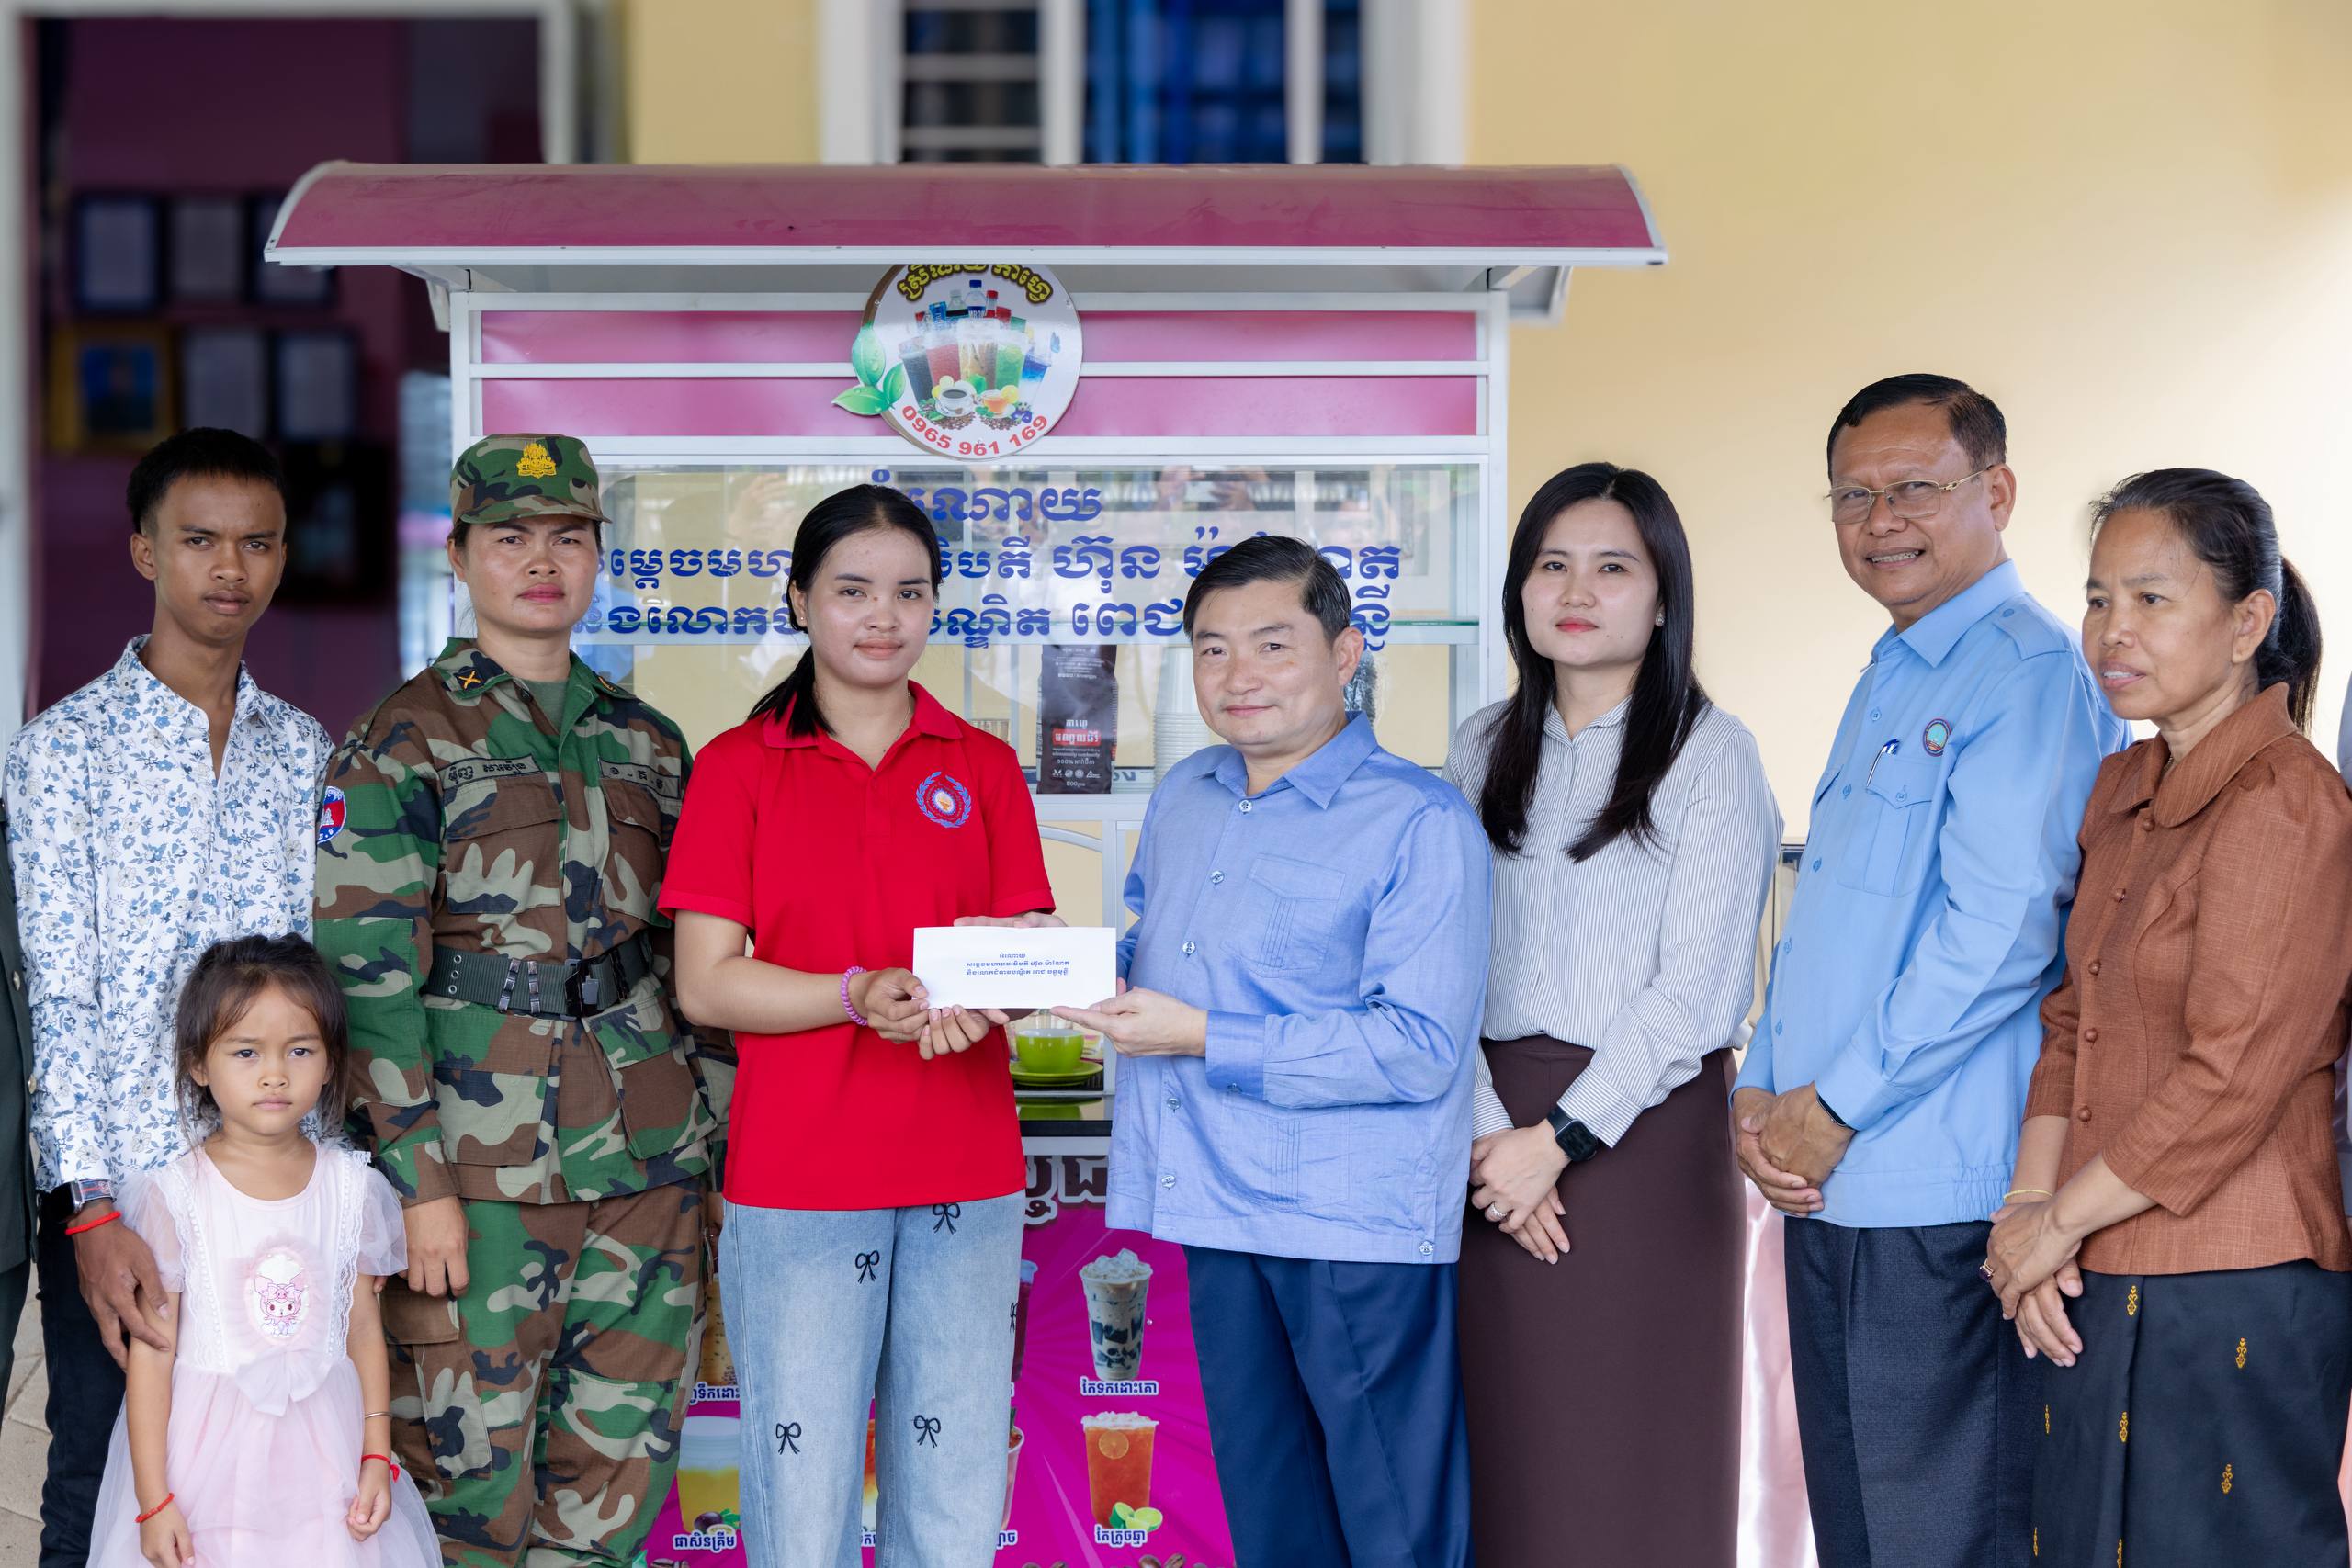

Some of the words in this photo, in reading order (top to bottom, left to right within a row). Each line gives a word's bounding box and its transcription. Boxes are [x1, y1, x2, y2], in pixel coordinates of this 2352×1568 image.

[902, 405, 952, 449] 0965
[958, 441, 1000, 456] 961
[1009, 415, 1047, 447] 169
[1053, 536, 1161, 593] ហ៊ុន
